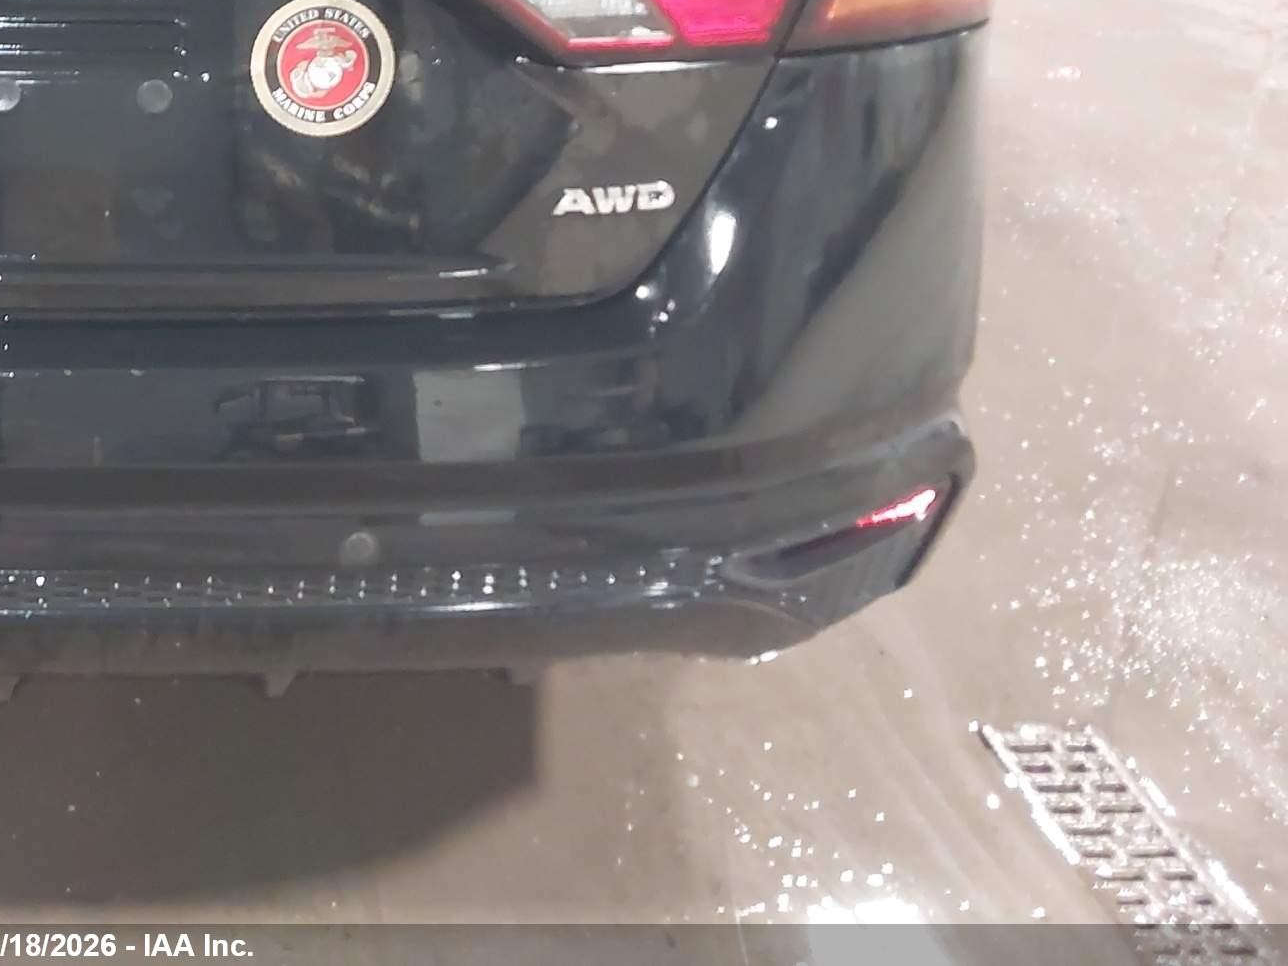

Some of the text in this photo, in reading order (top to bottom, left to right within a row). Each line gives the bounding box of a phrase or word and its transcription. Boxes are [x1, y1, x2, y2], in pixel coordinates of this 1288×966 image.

[272, 8, 370, 43] UNITED STATES
[272, 81, 376, 122] MARINE CORPS
[552, 179, 675, 215] AWD
